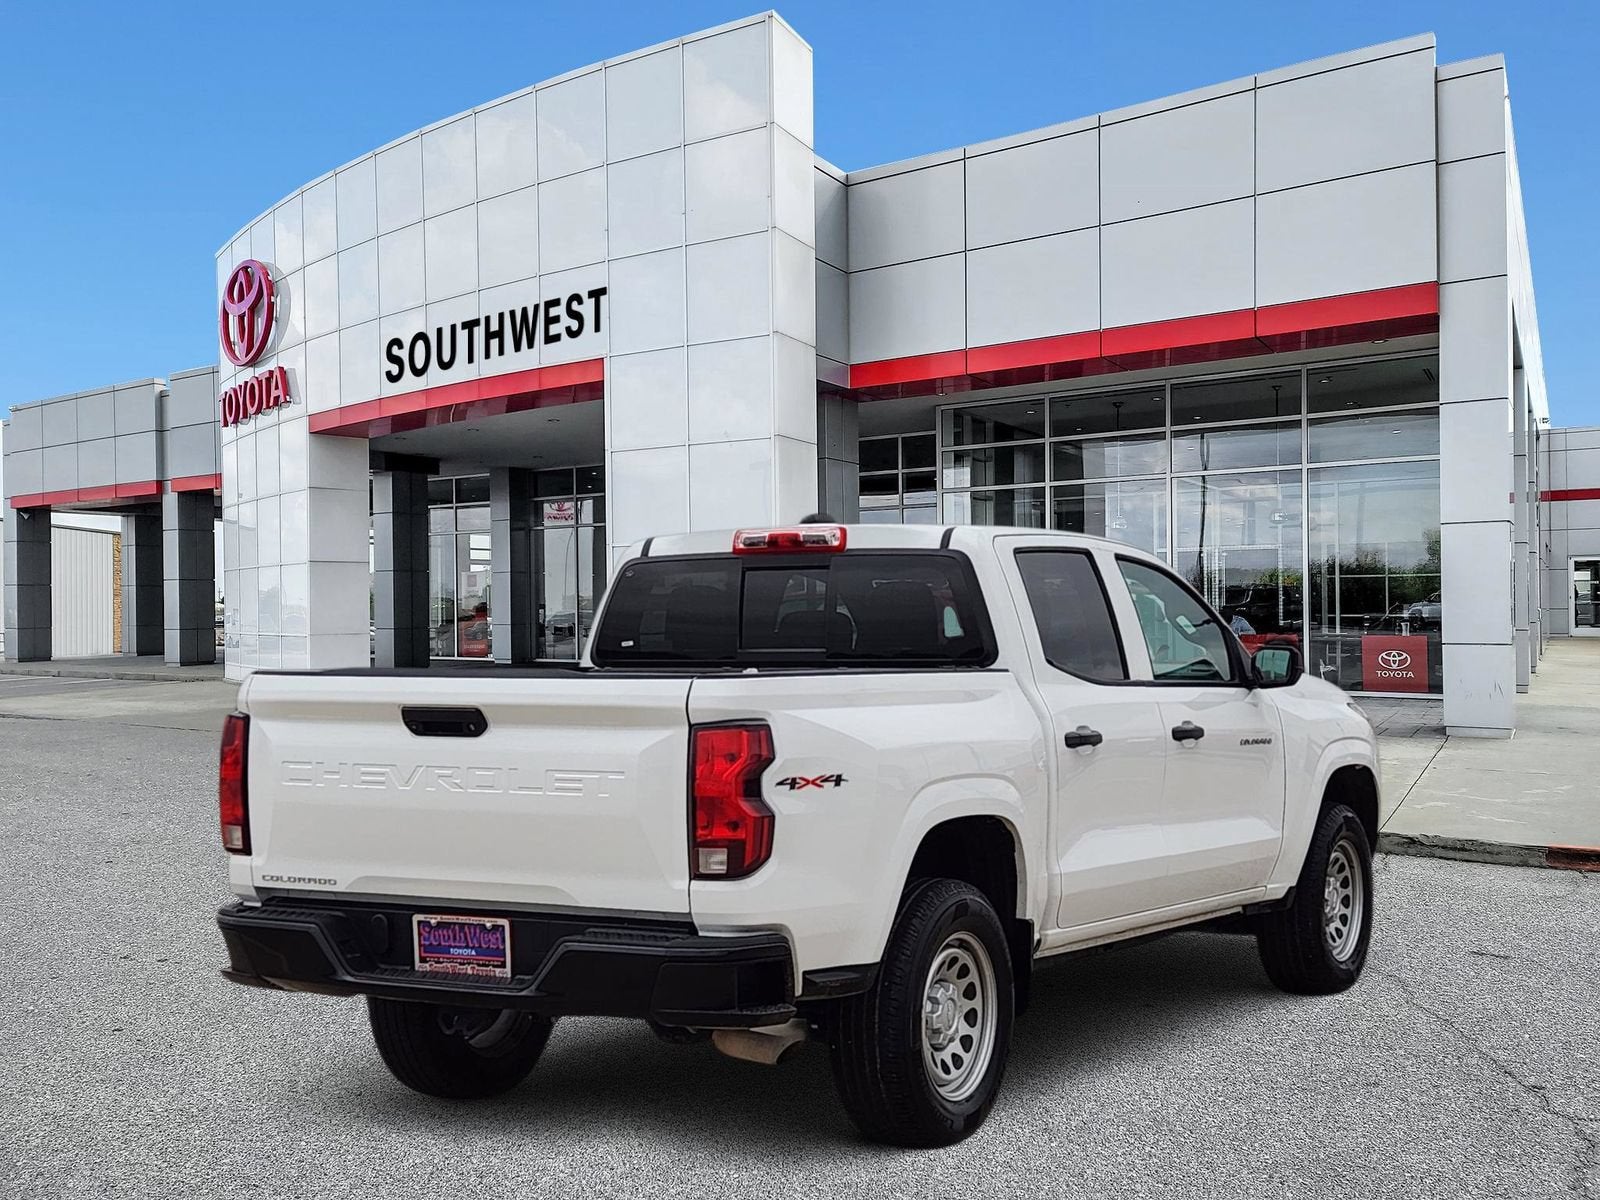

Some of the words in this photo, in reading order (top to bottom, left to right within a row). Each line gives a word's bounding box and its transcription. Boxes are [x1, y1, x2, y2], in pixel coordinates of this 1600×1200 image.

[385, 286, 608, 384] SOUTHWEST
[219, 366, 289, 428] TOYOTA
[1375, 670, 1415, 678] TOYOTA
[281, 760, 625, 798] CHEVROLET
[262, 874, 338, 886] COLORADO
[450, 948, 477, 956] TOYOTA
